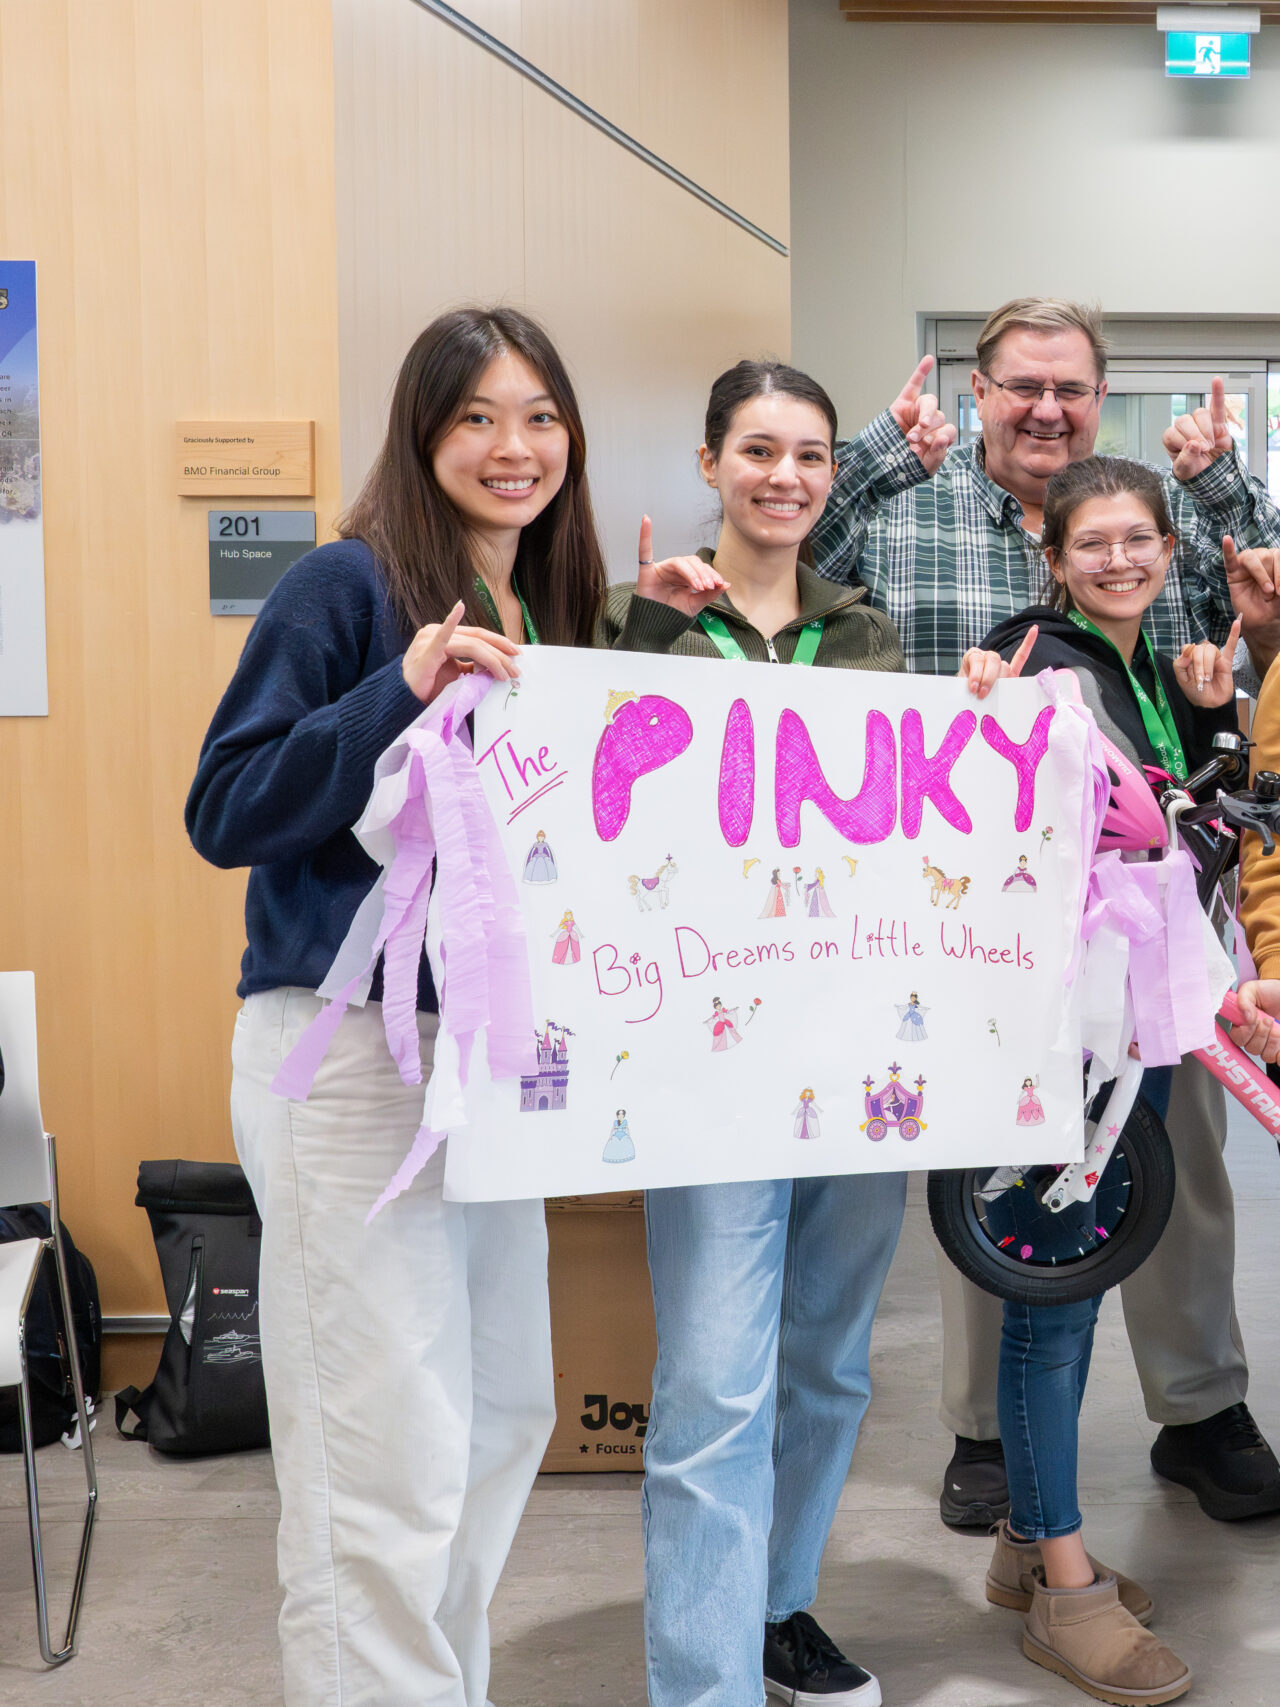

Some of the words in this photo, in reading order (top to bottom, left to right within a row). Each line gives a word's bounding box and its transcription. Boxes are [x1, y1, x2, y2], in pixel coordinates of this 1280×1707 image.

[184, 467, 207, 475] BMO
[210, 466, 250, 476] Financial
[252, 467, 280, 477] Group
[219, 516, 260, 536] 201
[220, 550, 240, 558] Hub
[242, 549, 272, 560] Space
[476, 730, 558, 800] The
[592, 694, 1056, 847] PINKY
[593, 944, 662, 1024] Big
[674, 926, 795, 978] Dreams
[810, 940, 838, 960] on
[852, 914, 924, 960] Little
[940, 921, 1034, 970] Wheels
[220, 1288, 249, 1296] seaspan
[580, 1394, 650, 1438] Joy
[596, 1444, 636, 1454] Focus
